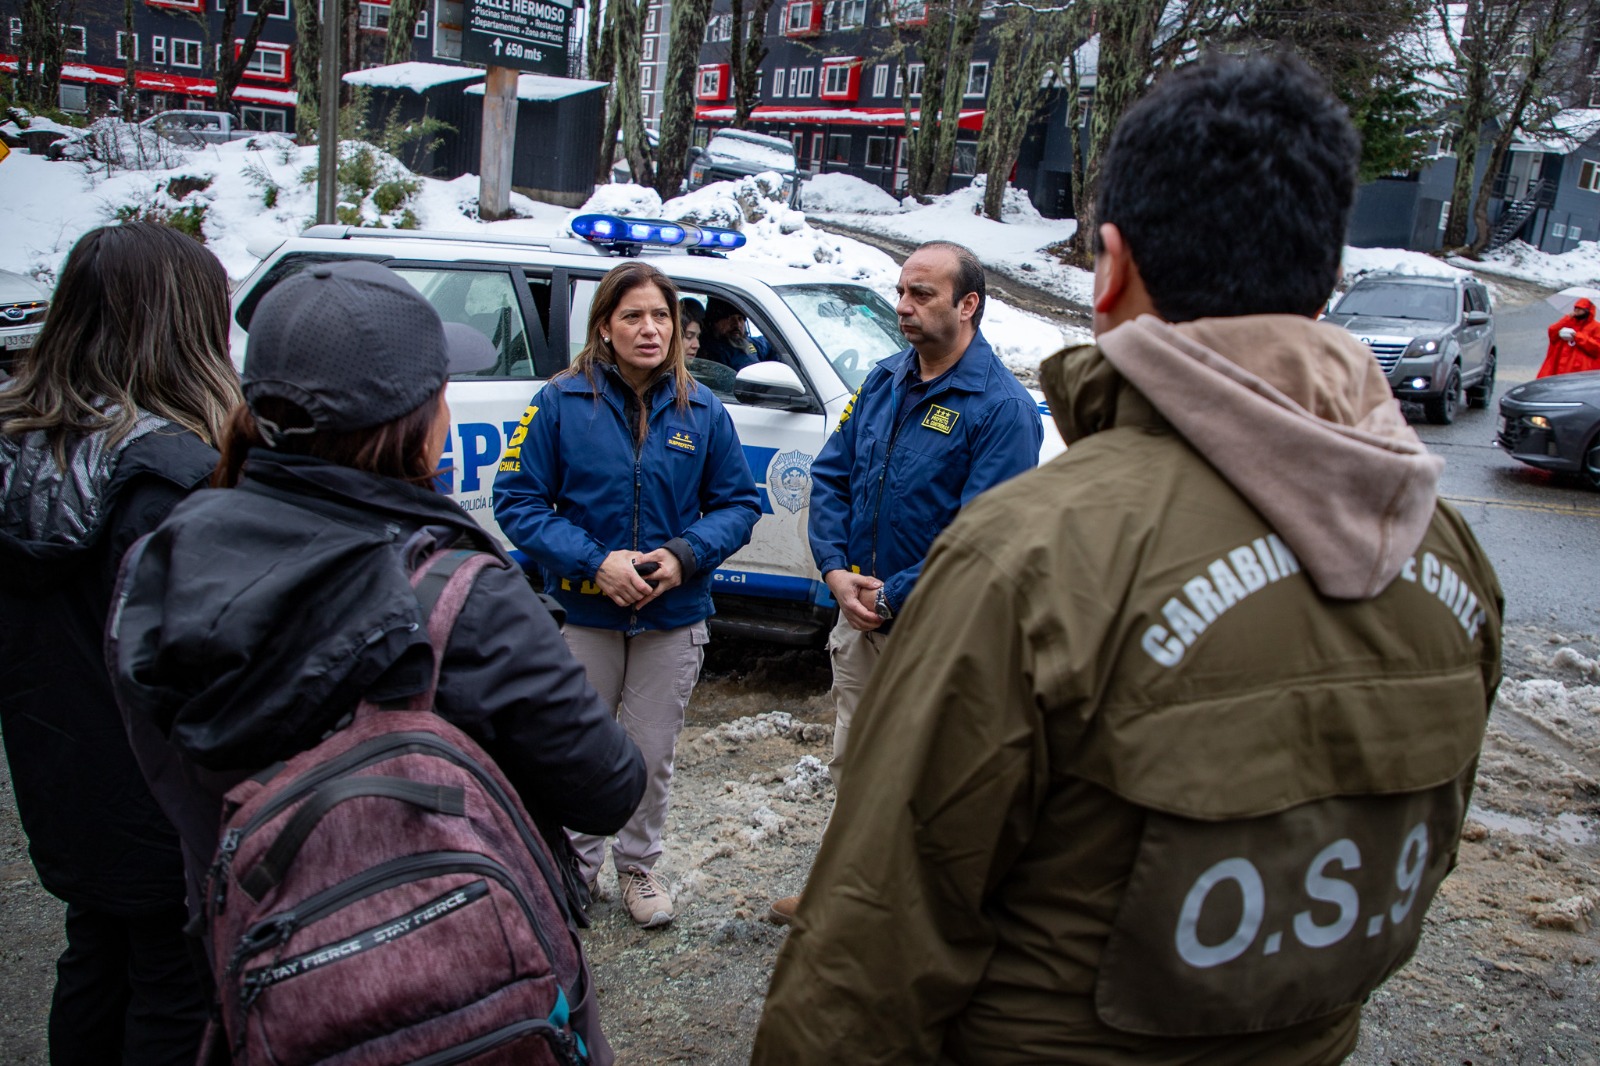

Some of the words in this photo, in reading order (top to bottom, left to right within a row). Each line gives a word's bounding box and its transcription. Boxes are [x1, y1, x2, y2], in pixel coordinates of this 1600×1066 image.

[475, 5, 501, 19] Piscinas
[501, 11, 528, 25] Termales
[534, 19, 564, 32] Restaurant
[512, 0, 565, 22] HERMOSO
[474, 16, 521, 34] Departamentos
[525, 26, 539, 38] Zona
[539, 30, 547, 39] de
[547, 32, 564, 42] Picnic
[505, 41, 524, 58] 650
[524, 47, 543, 61] mts
[499, 460, 521, 472] CHILE
[460, 496, 487, 511] POLICÍA
[713, 573, 746, 584] e.cl
[1141, 533, 1301, 668] CARABIN
[1401, 555, 1417, 583] E
[1175, 822, 1429, 969] O.S.9
[264, 962, 299, 983] TAY
[302, 940, 362, 969] FIERCE
[372, 918, 411, 943] STAY
[414, 892, 468, 925] FIERCE
